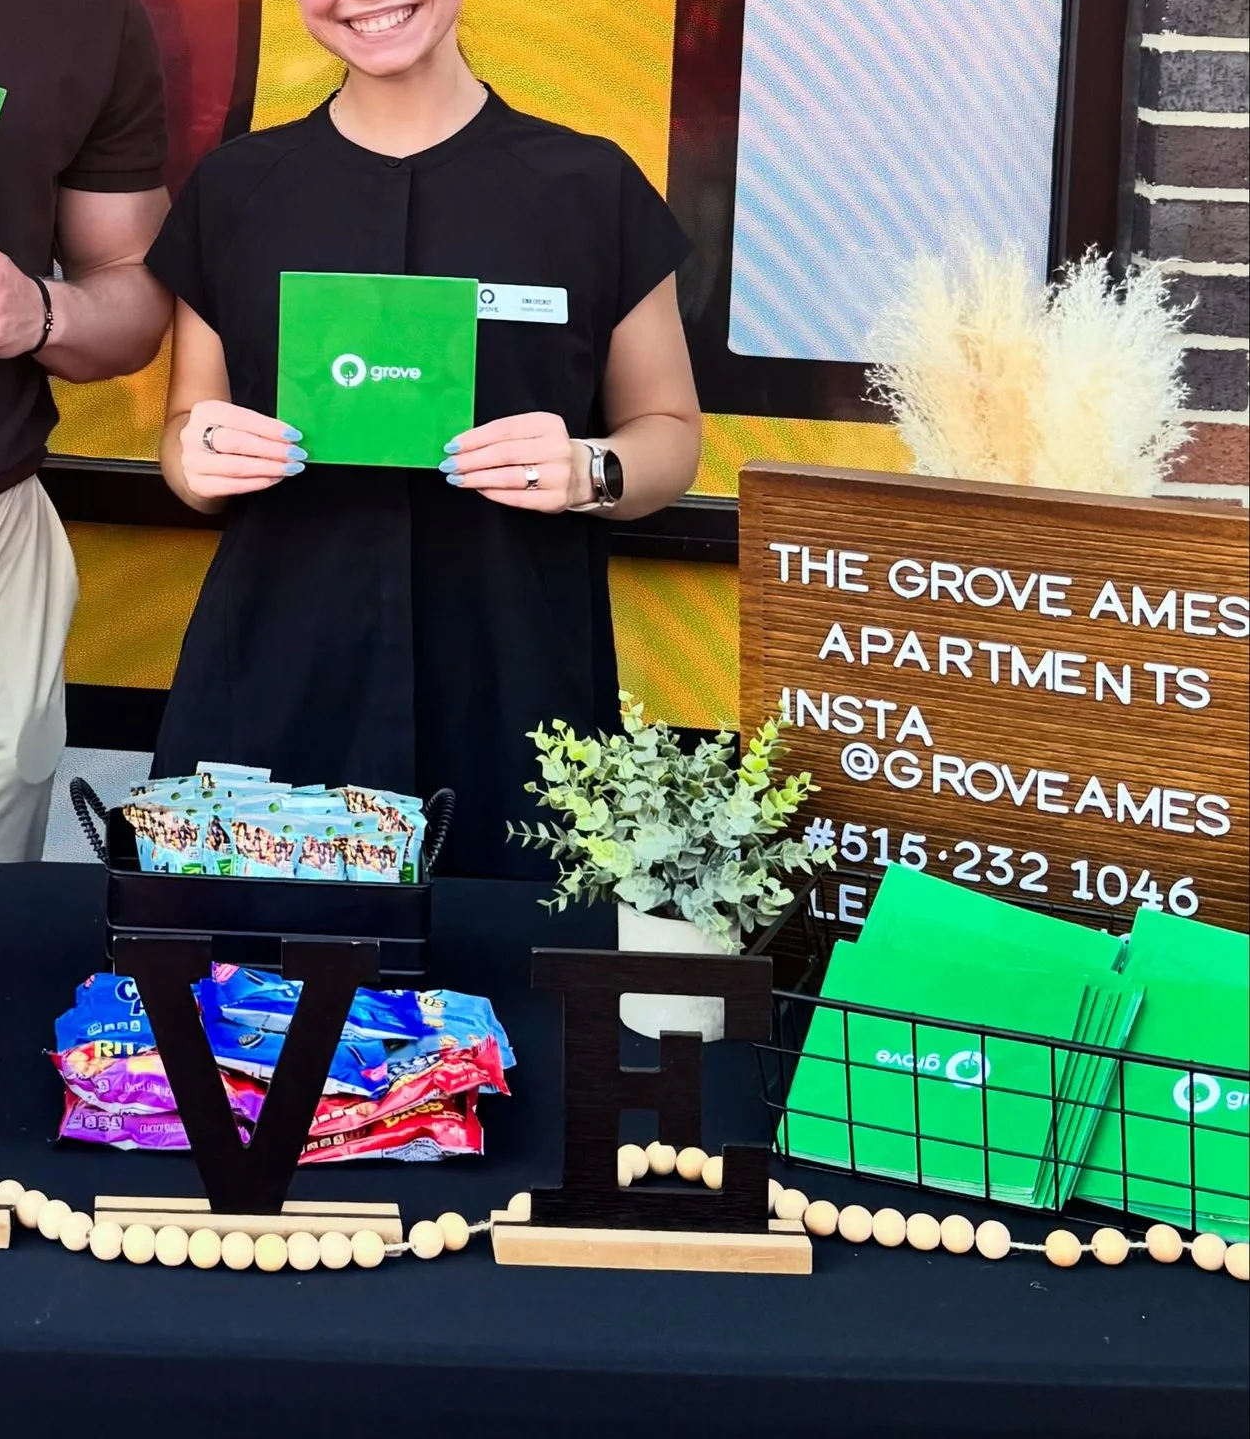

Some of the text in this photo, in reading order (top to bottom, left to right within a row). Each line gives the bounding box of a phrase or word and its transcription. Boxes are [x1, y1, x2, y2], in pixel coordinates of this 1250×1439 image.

[370, 365, 421, 382] grove
[769, 542, 1250, 639] THE GROVE AMES
[779, 688, 933, 747] INSTA
[841, 743, 1231, 837] @GROVEAMES
[1072, 859, 1200, 918] 1046
[94, 1040, 144, 1057] RIT
